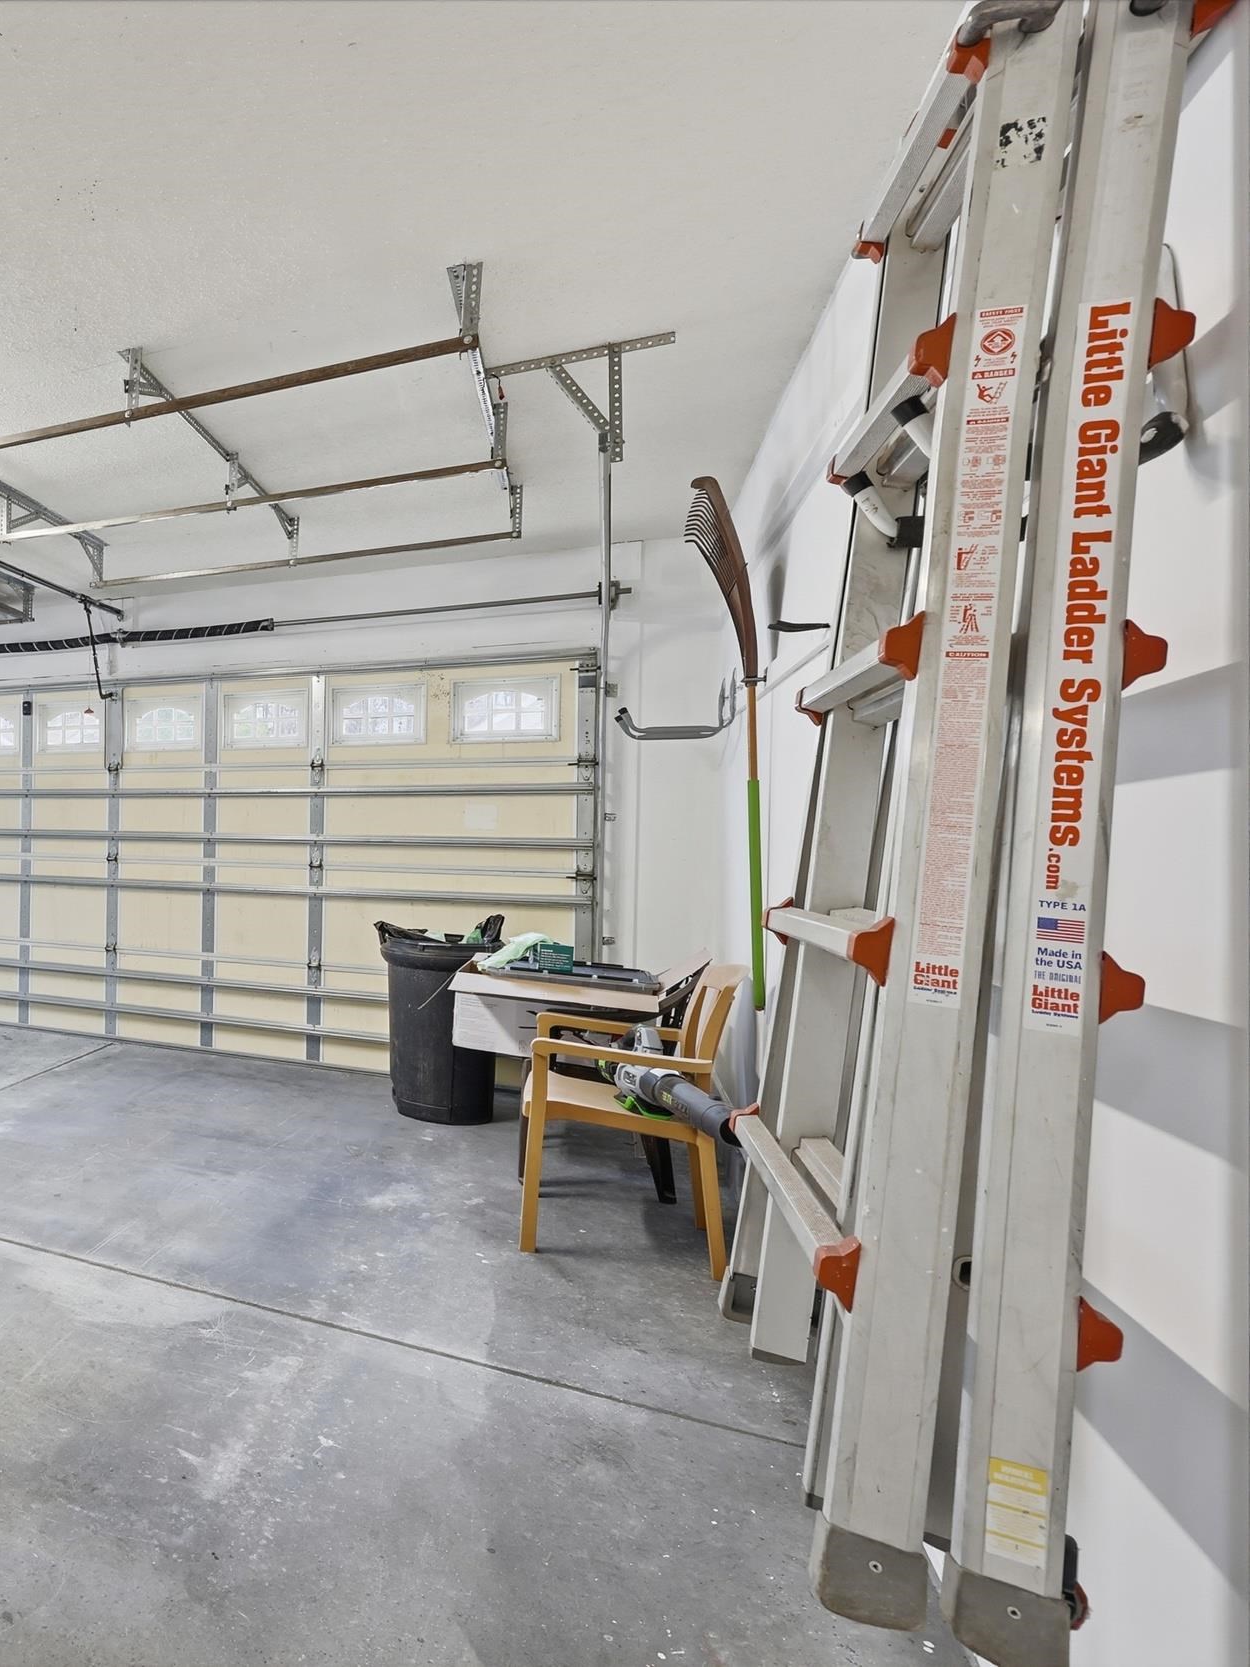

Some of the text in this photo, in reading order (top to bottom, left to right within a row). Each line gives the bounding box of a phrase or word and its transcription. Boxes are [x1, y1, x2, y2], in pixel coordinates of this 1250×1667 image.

[1082, 302, 1131, 408] Little
[1074, 419, 1120, 519] Giant
[1063, 530, 1112, 664] Ladder
[1038, 900, 1086, 912] TYPE 1A
[1037, 946, 1082, 960] Made in
[914, 961, 960, 978] Little
[1035, 957, 1083, 971] the USA
[1034, 969, 1047, 981] THE
[1032, 984, 1081, 1002] Little
[1031, 997, 1079, 1014] Giant
